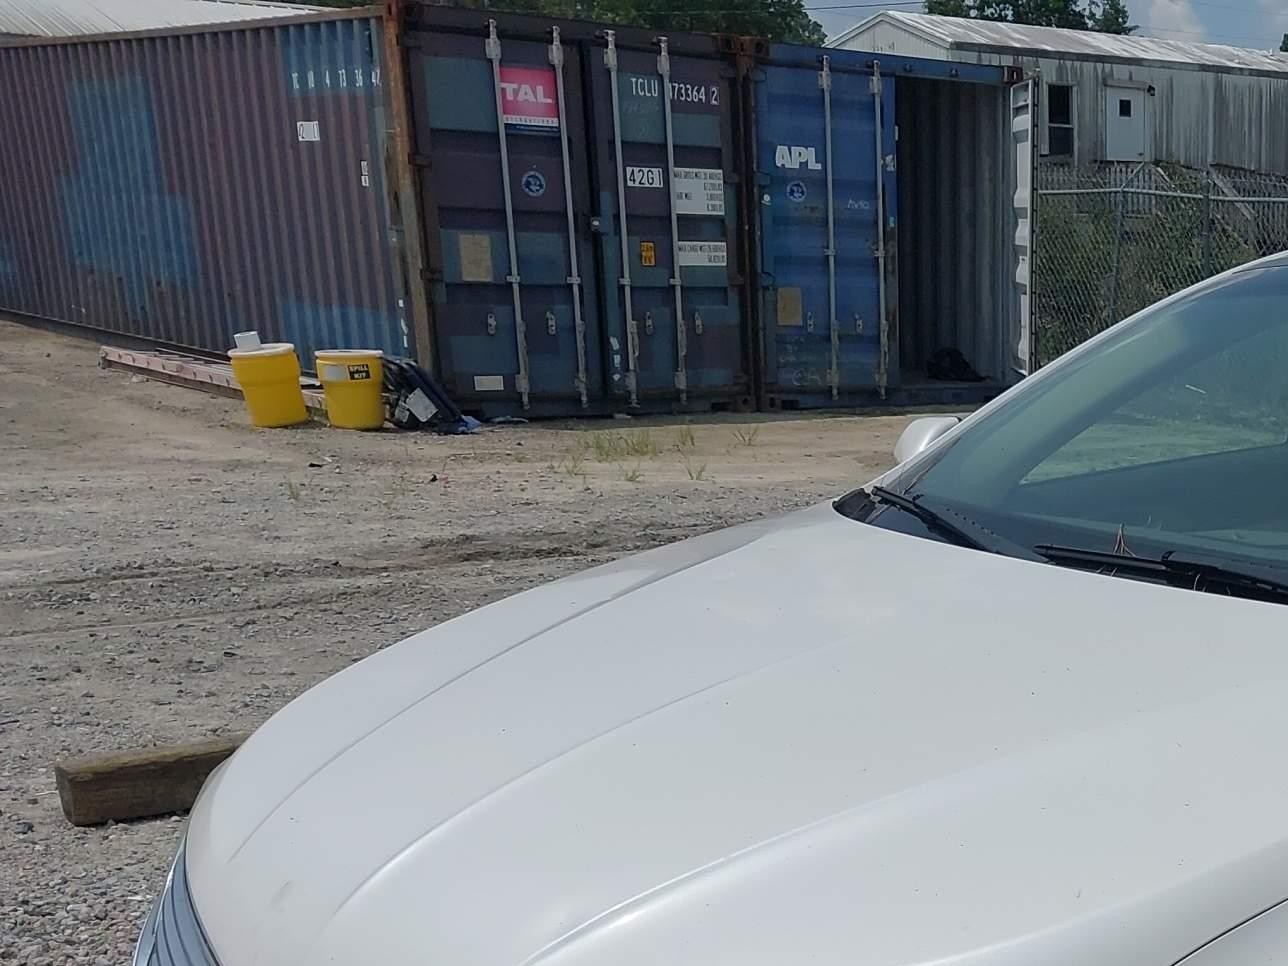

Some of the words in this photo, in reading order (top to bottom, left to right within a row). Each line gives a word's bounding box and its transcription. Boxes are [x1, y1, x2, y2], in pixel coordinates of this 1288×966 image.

[500, 82, 553, 104] TAL
[630, 77, 658, 97] TCLU
[775, 145, 822, 170] APL
[628, 168, 662, 186] 42G1
